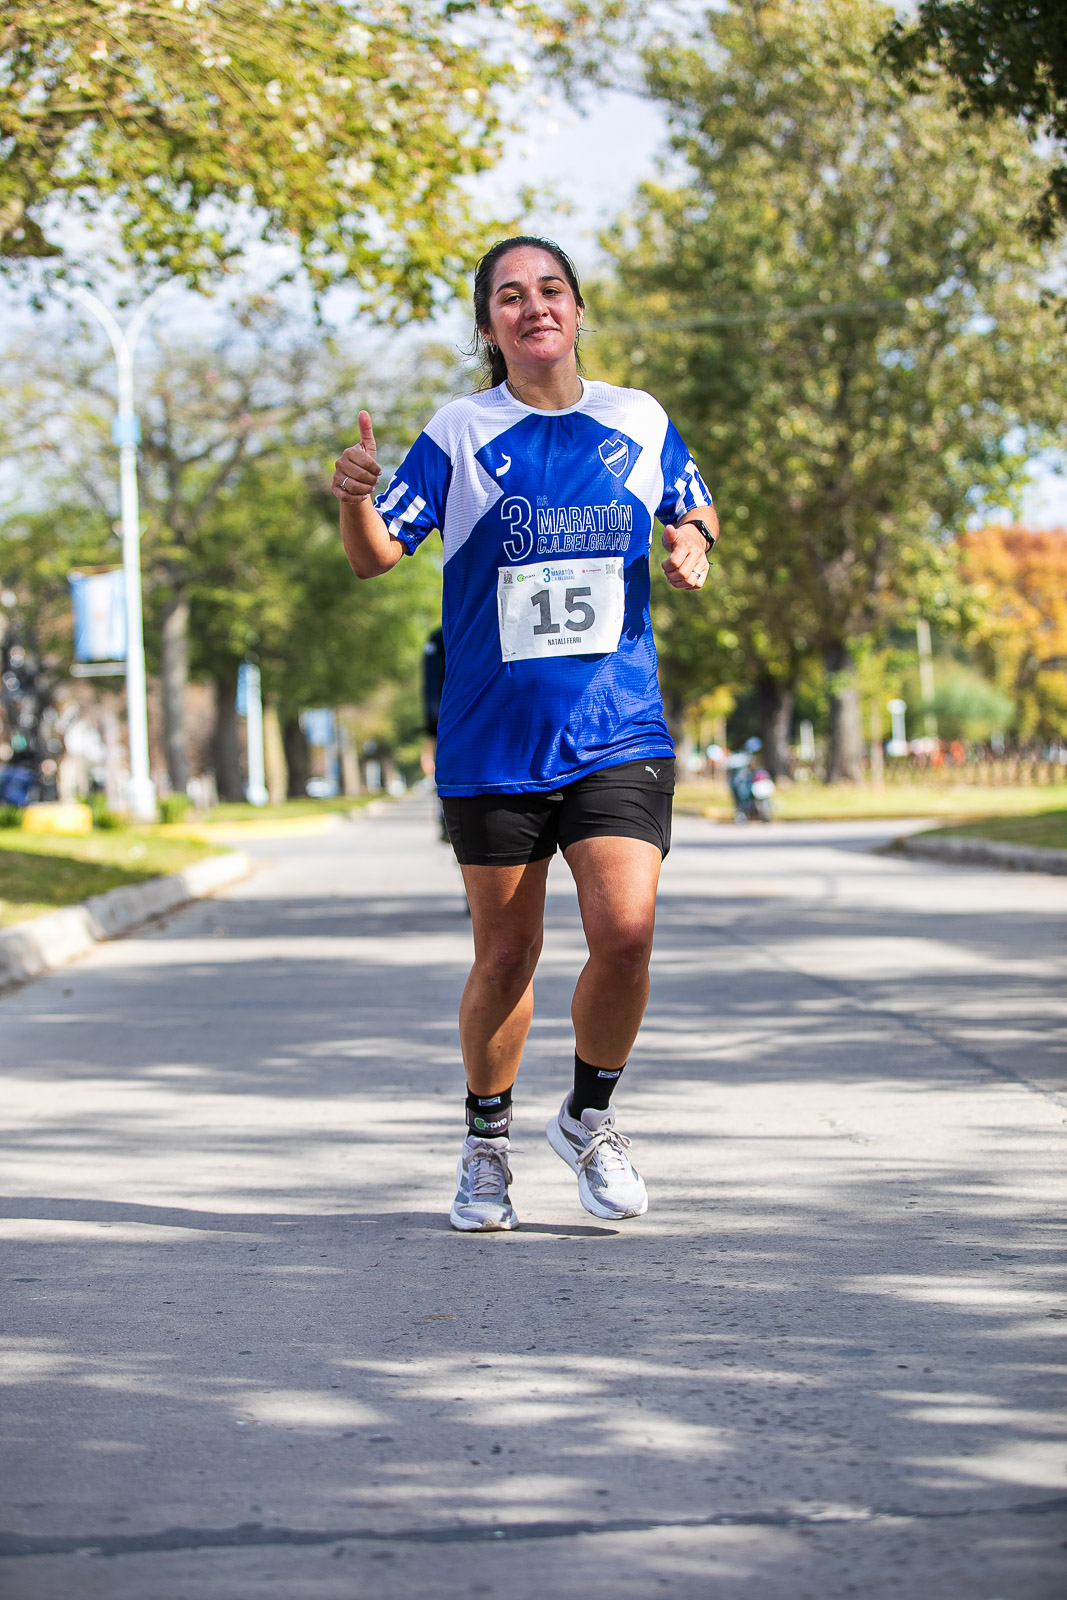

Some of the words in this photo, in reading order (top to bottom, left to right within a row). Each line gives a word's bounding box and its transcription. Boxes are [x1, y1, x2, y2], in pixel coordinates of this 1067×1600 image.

[501, 496, 533, 562] 3
[537, 500, 633, 535] MARATÓN
[543, 567, 551, 583] 3
[530, 586, 595, 635] 15
[547, 637, 566, 646] NATALI
[567, 636, 582, 644] FERRI
